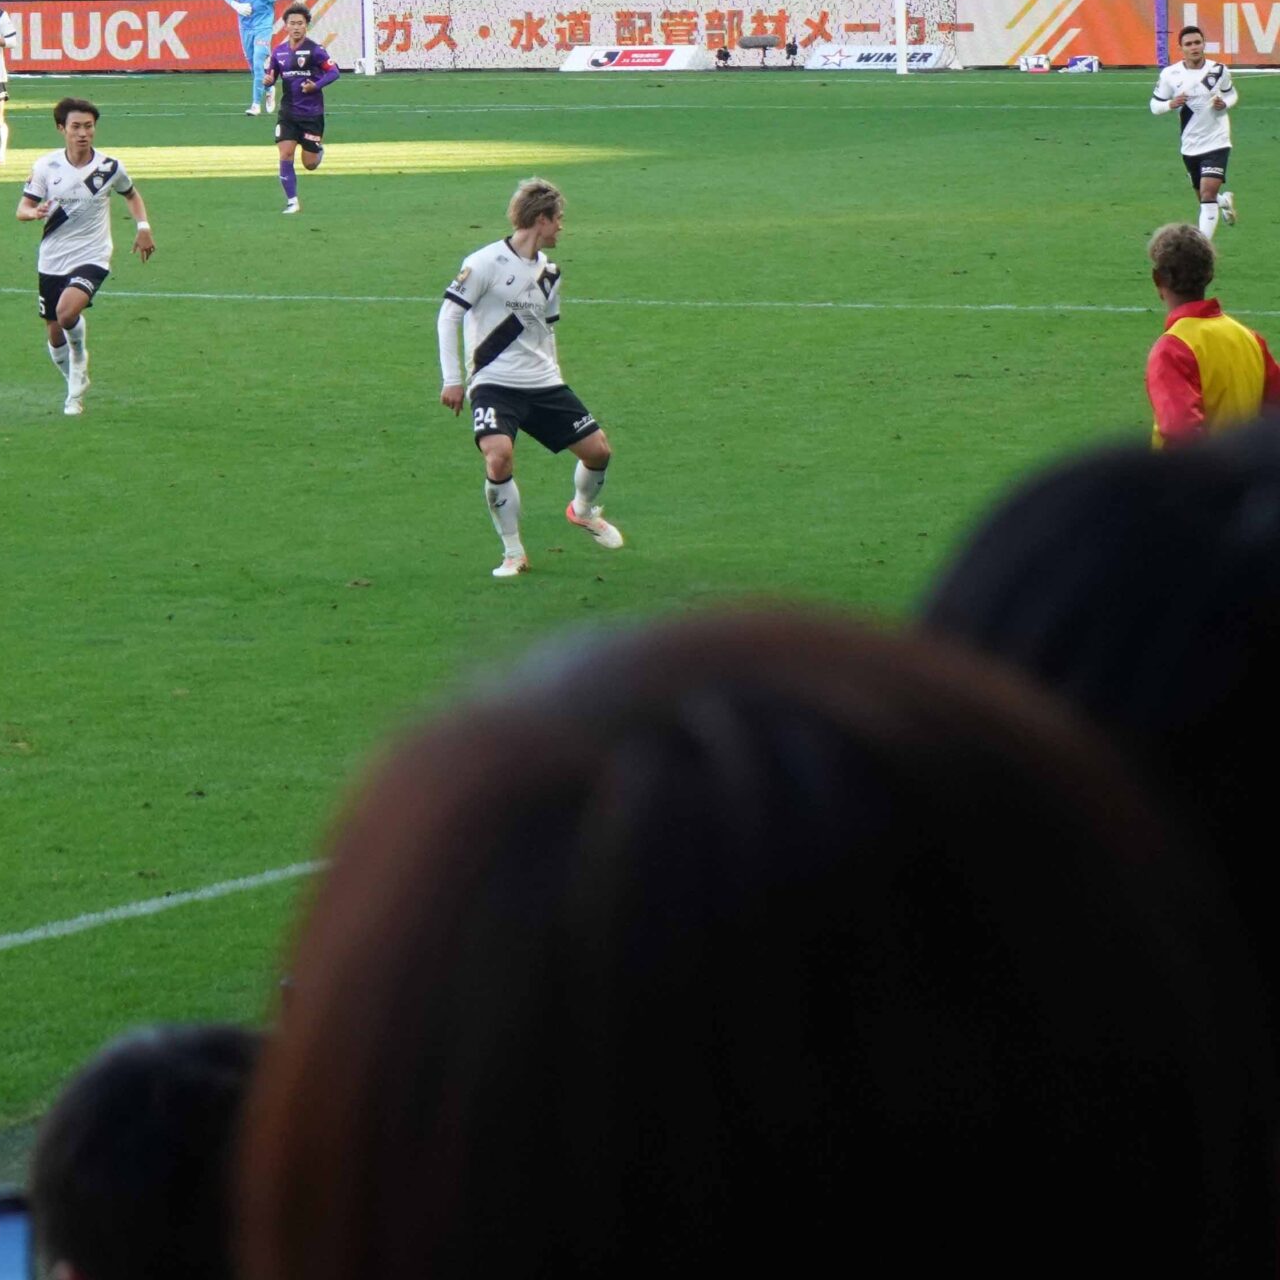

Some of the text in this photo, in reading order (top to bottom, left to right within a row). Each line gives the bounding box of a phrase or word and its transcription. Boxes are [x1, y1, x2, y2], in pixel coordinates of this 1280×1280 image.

[377, 10, 593, 53] ガス・水道
[856, 52, 934, 63] WINER
[473, 406, 498, 432] 24
